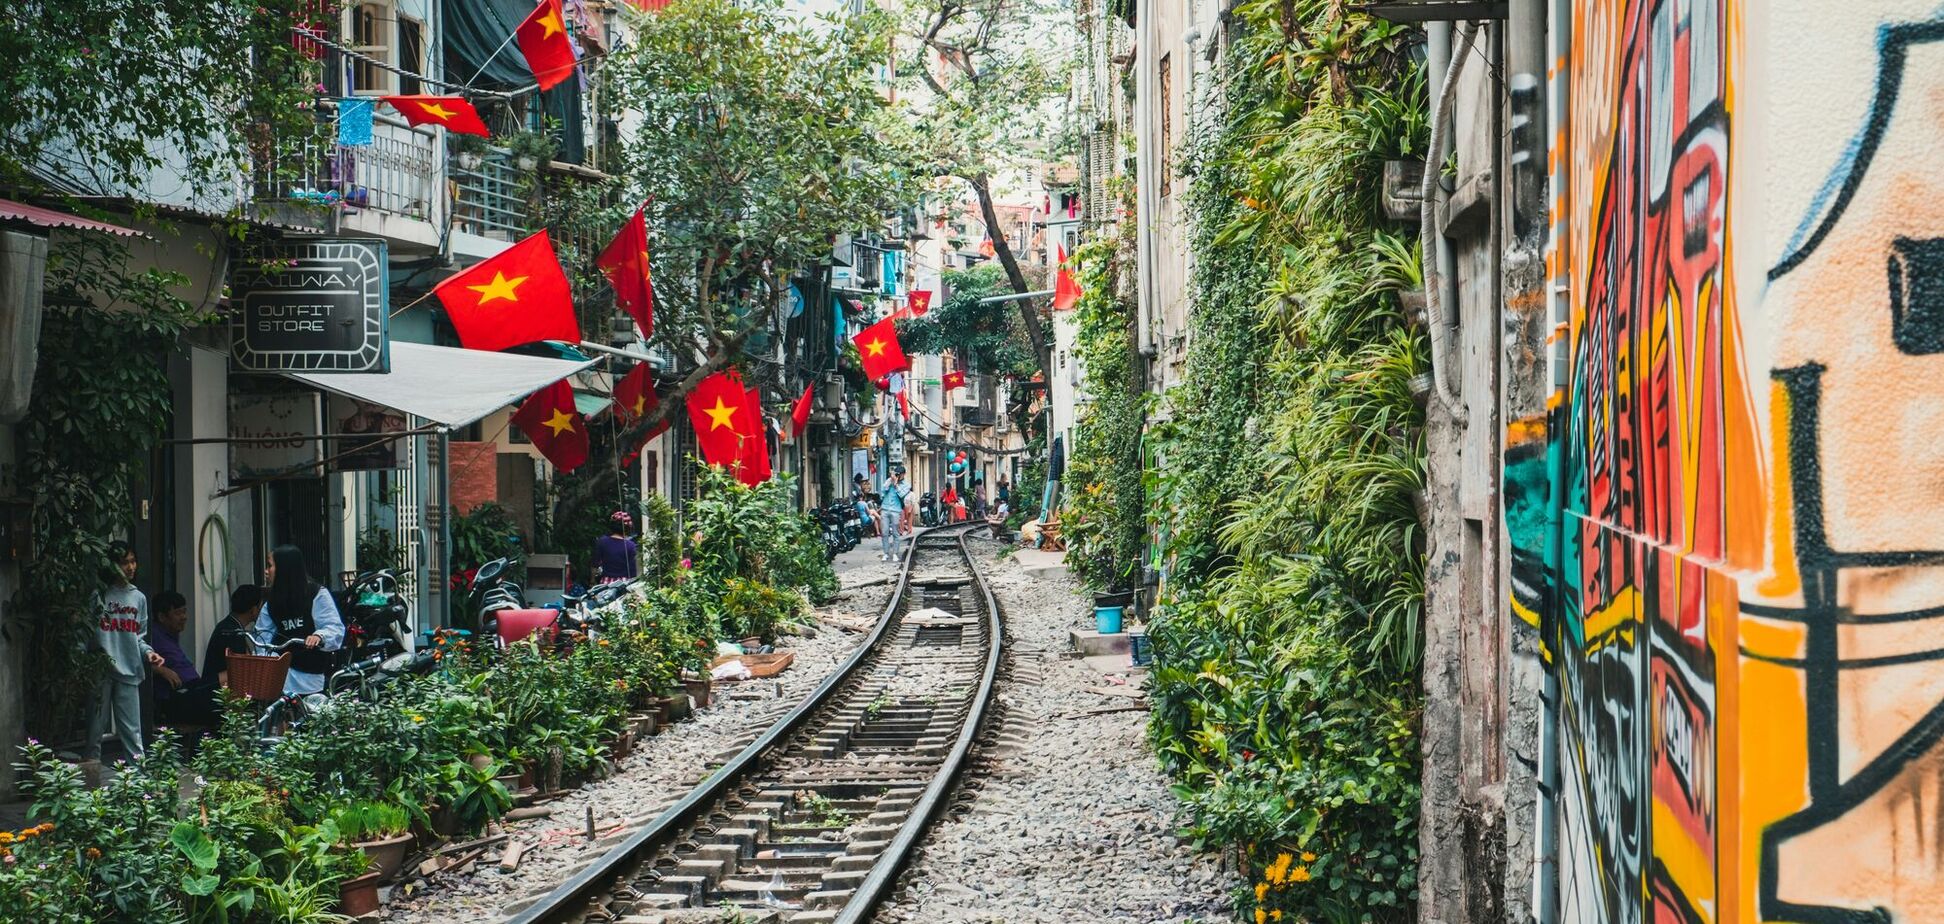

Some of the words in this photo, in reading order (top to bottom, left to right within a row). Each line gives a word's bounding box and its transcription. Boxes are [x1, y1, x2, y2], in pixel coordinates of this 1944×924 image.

[235, 273, 361, 288] RAILWAY
[258, 305, 334, 316] OUTFIT
[258, 320, 324, 331] STORE
